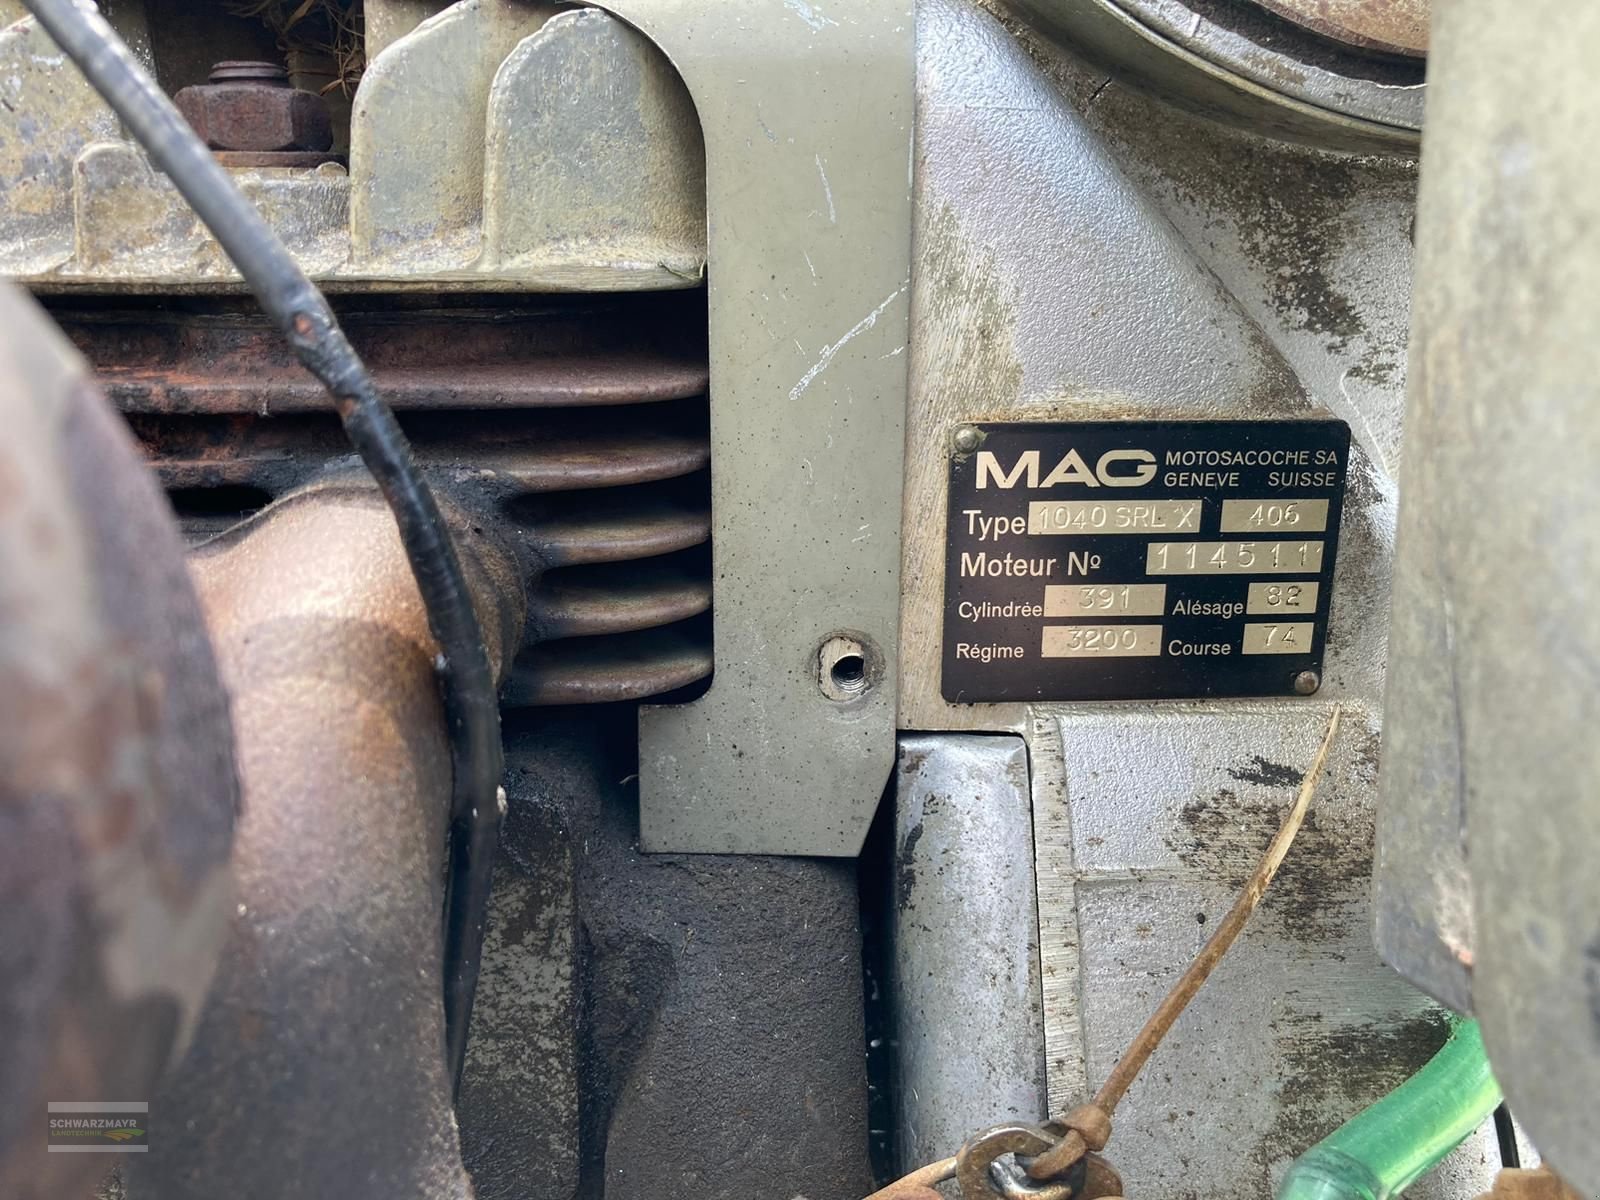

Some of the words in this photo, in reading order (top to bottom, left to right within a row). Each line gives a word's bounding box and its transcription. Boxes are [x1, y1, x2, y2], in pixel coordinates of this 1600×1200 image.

[975, 448, 1158, 489] MAG
[1165, 451, 1309, 466] MOTOSACOCHE
[1314, 450, 1338, 465] SA
[1163, 472, 1240, 487] GENEVE
[1268, 472, 1336, 486] SUISSE
[963, 510, 1026, 541] Type
[1039, 505, 1107, 528] 1040
[1248, 503, 1300, 527] 406
[960, 551, 1056, 577] Moteur
[958, 600, 1042, 623] Cylindrée
[1079, 587, 1130, 609] 391
[1171, 599, 1244, 621] Alésage
[1266, 584, 1301, 607] 82
[956, 640, 1024, 660] Régime
[1067, 628, 1138, 651] 3200
[1168, 638, 1231, 656] Course
[1262, 624, 1297, 648] 74
